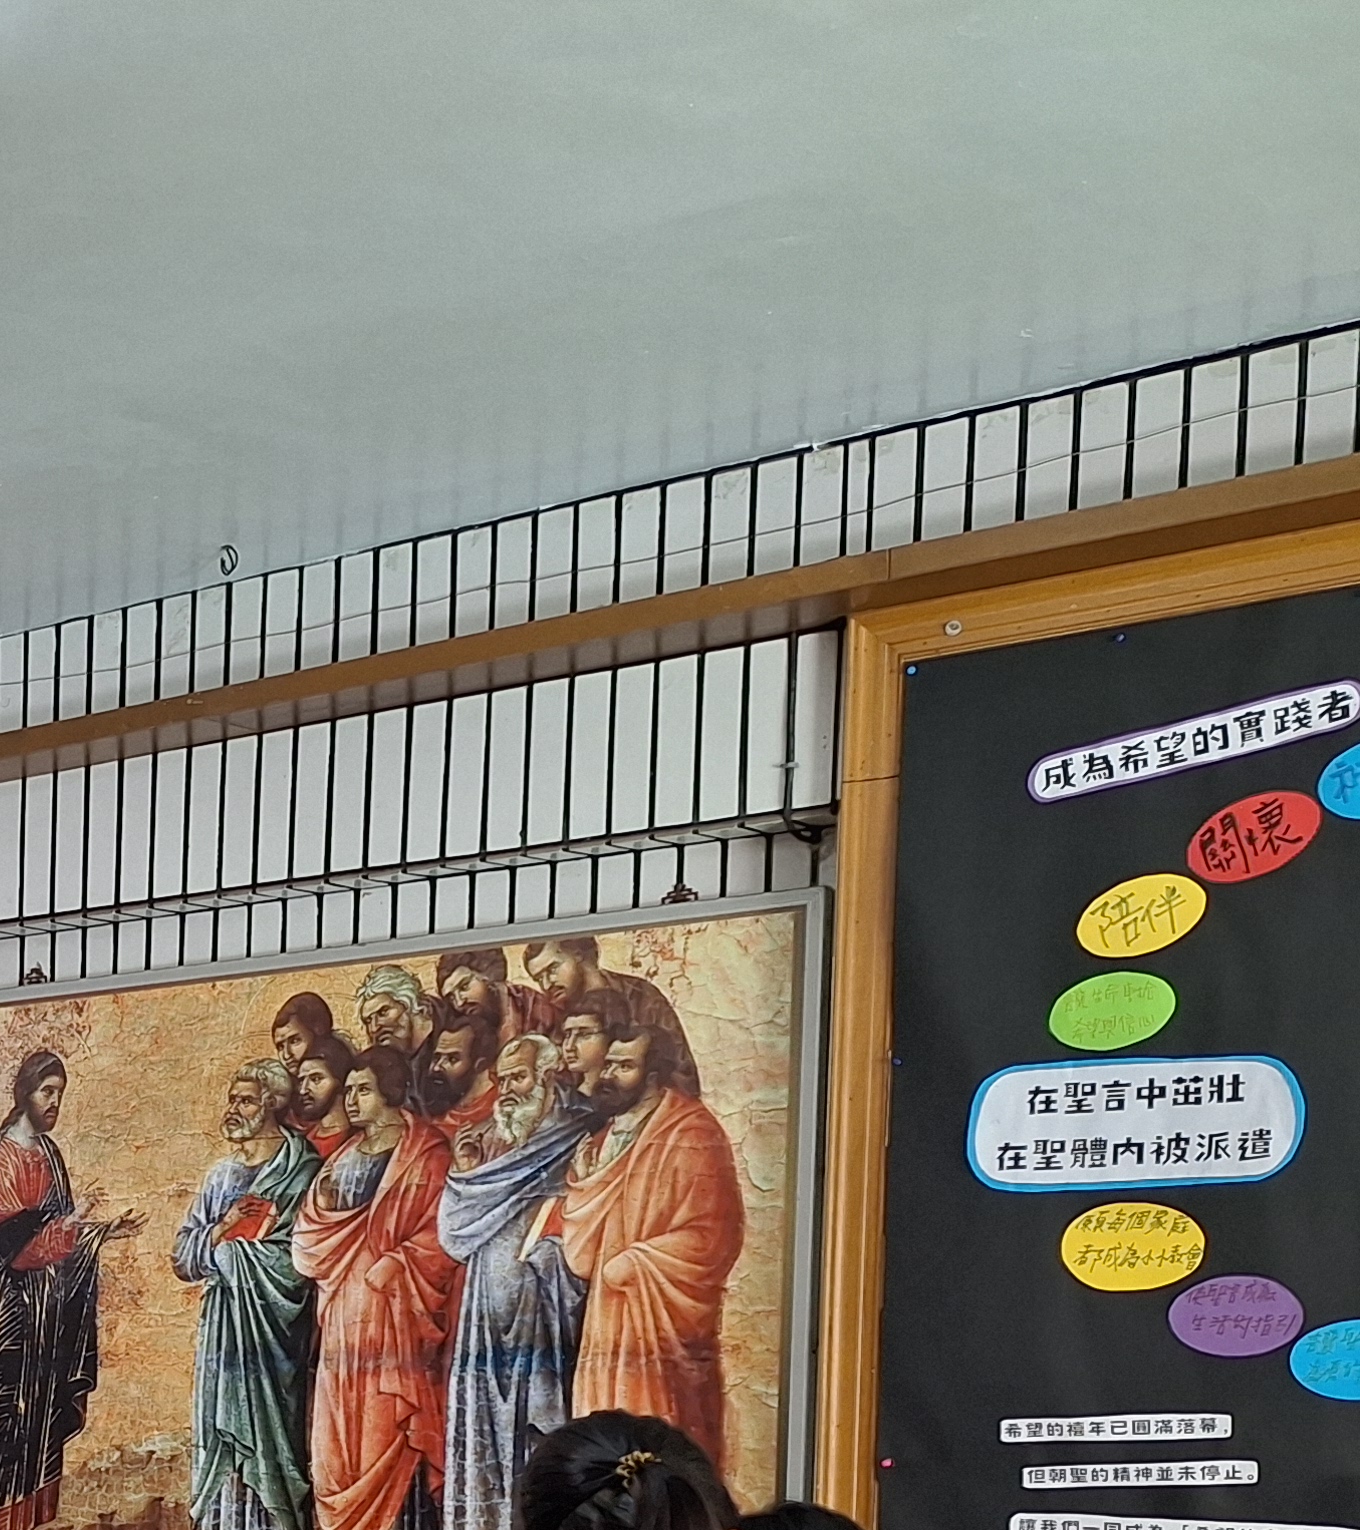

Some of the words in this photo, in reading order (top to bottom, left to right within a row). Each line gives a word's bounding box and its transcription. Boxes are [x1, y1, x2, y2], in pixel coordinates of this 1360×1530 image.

[1041, 690, 1354, 793] 成為希望的實踐者
[1198, 796, 1305, 874] 關懷
[1089, 884, 1187, 949] 陪伴
[1026, 1073, 1247, 1115] 在聖言中茁壯
[996, 1128, 1274, 1172] 在聖體內被派遣
